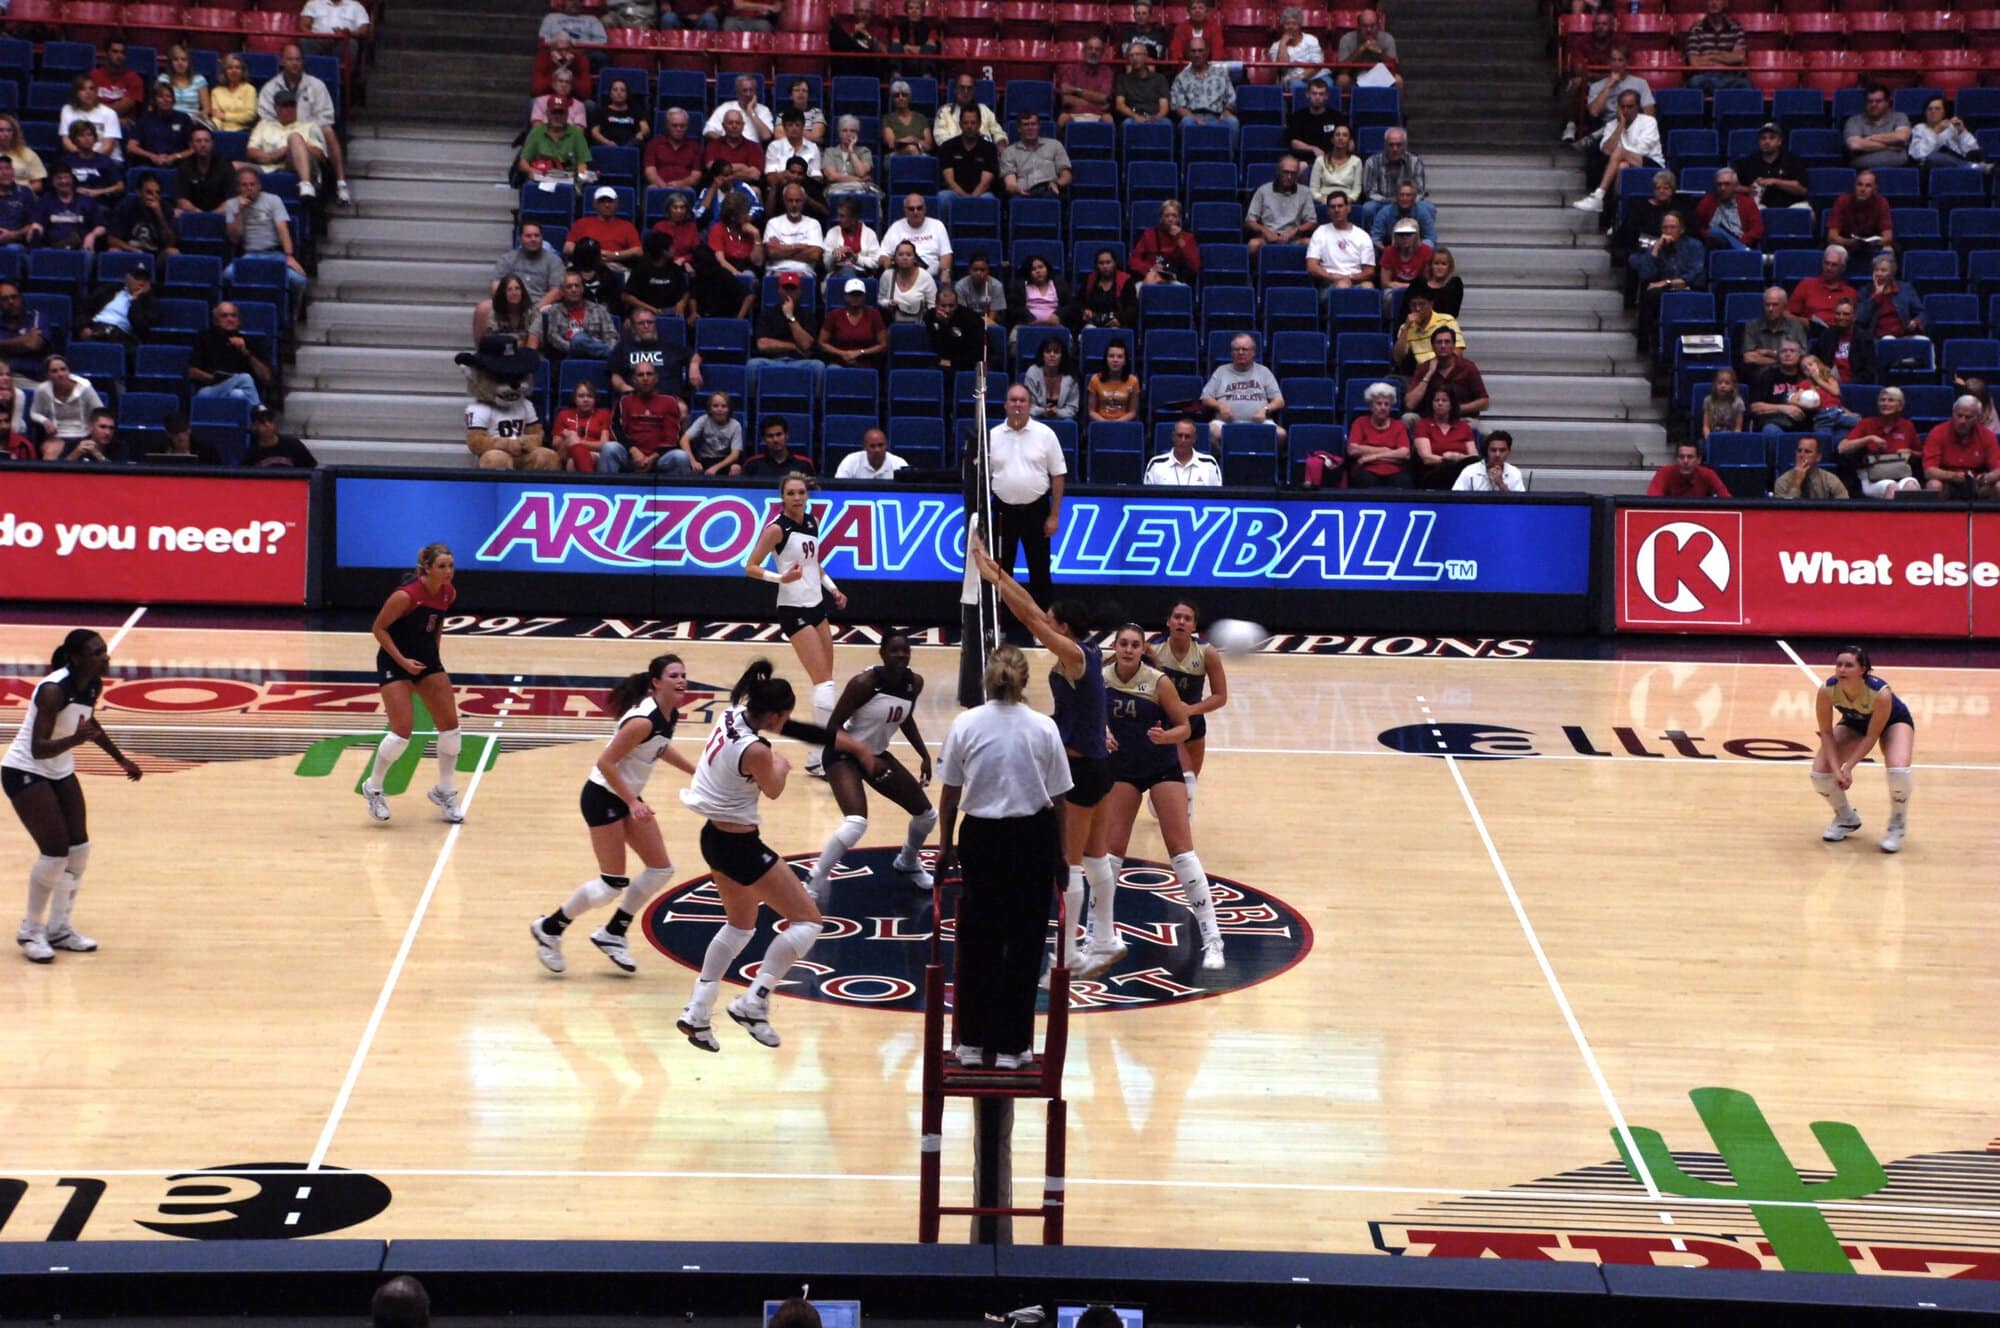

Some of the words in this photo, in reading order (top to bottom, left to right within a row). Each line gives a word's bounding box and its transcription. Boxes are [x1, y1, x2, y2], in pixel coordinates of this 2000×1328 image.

[630, 352, 664, 364] UMC
[55, 523, 136, 556] you
[148, 520, 286, 554] need?
[877, 499, 1444, 582] VLEYBALL
[802, 541, 815, 559] 99
[1779, 551, 1893, 586] What
[1905, 553, 2000, 588] else
[440, 615, 568, 637] 997
[1113, 699, 1137, 718] 24
